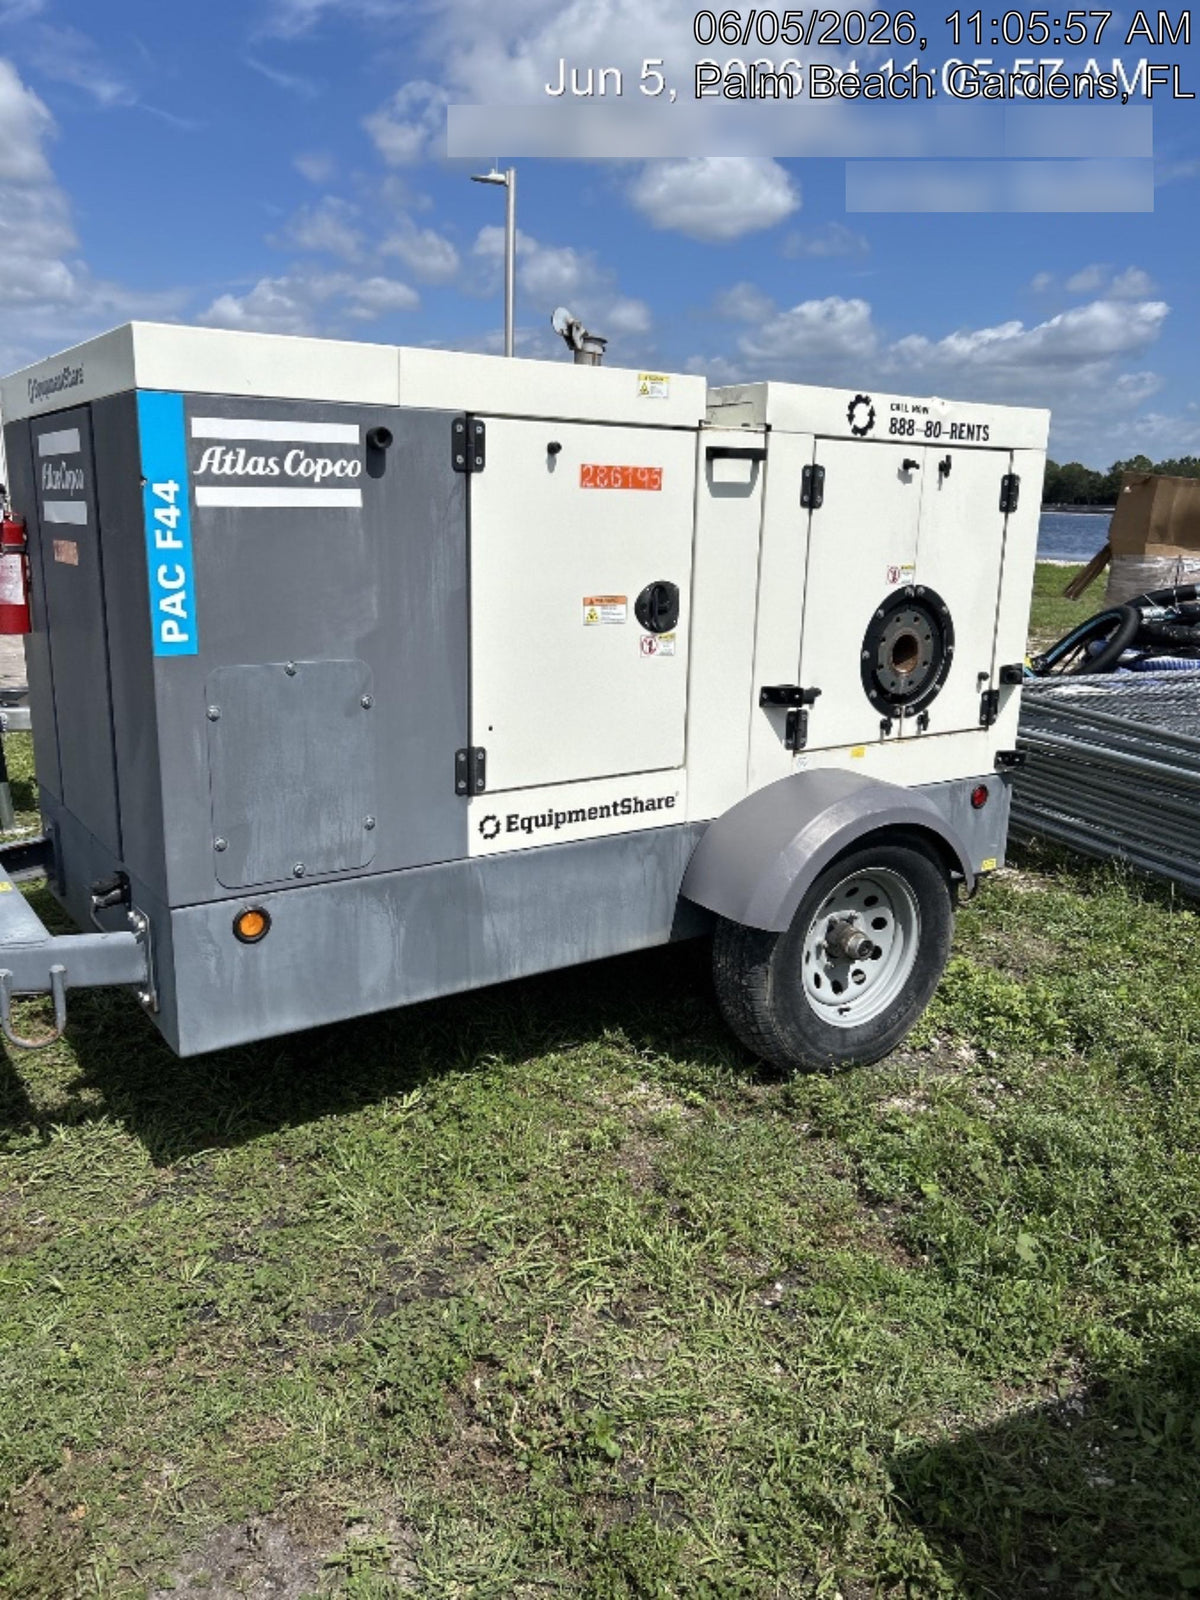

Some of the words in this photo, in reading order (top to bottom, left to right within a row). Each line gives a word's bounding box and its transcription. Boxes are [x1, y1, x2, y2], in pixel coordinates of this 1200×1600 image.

[888, 417, 990, 442] 888-80-RENTS
[193, 445, 280, 477] Atlas
[283, 448, 362, 483] Copco
[152, 479, 184, 550] F44
[157, 562, 190, 643] PAC
[505, 795, 676, 834] EquipmentShare
